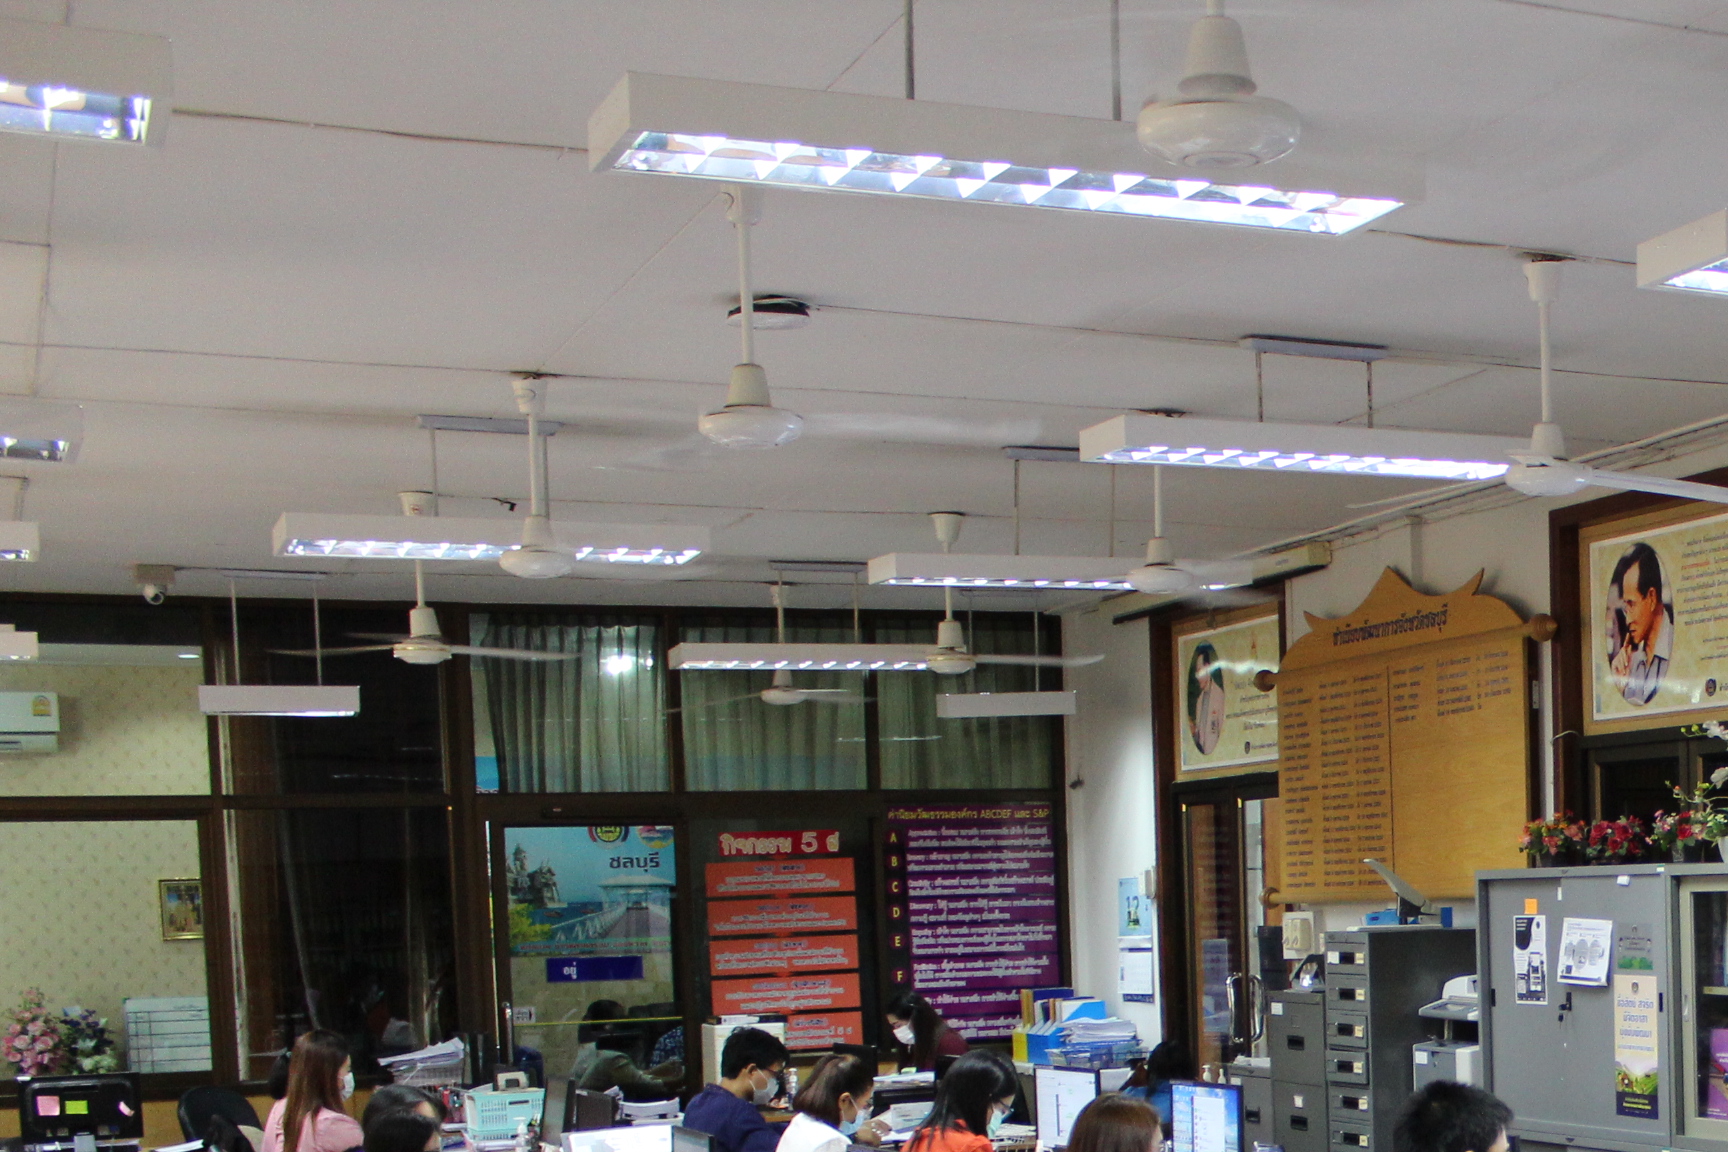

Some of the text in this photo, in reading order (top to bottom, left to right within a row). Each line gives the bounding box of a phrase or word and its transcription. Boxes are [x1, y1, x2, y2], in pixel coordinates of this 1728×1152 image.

[980, 810, 1012, 819] ABCDEF
[1033, 810, 1049, 819] S&P
[890, 833, 897, 843] A
[720, 831, 840, 856] กิจกรรม 5 ส
[609, 852, 660, 872] ชลบุรี
[891, 857, 898, 866] B
[892, 882, 898, 892] C
[893, 908, 900, 917] D
[895, 937, 901, 946] E
[563, 962, 577, 980] อยู่
[897, 972, 903, 981] F
